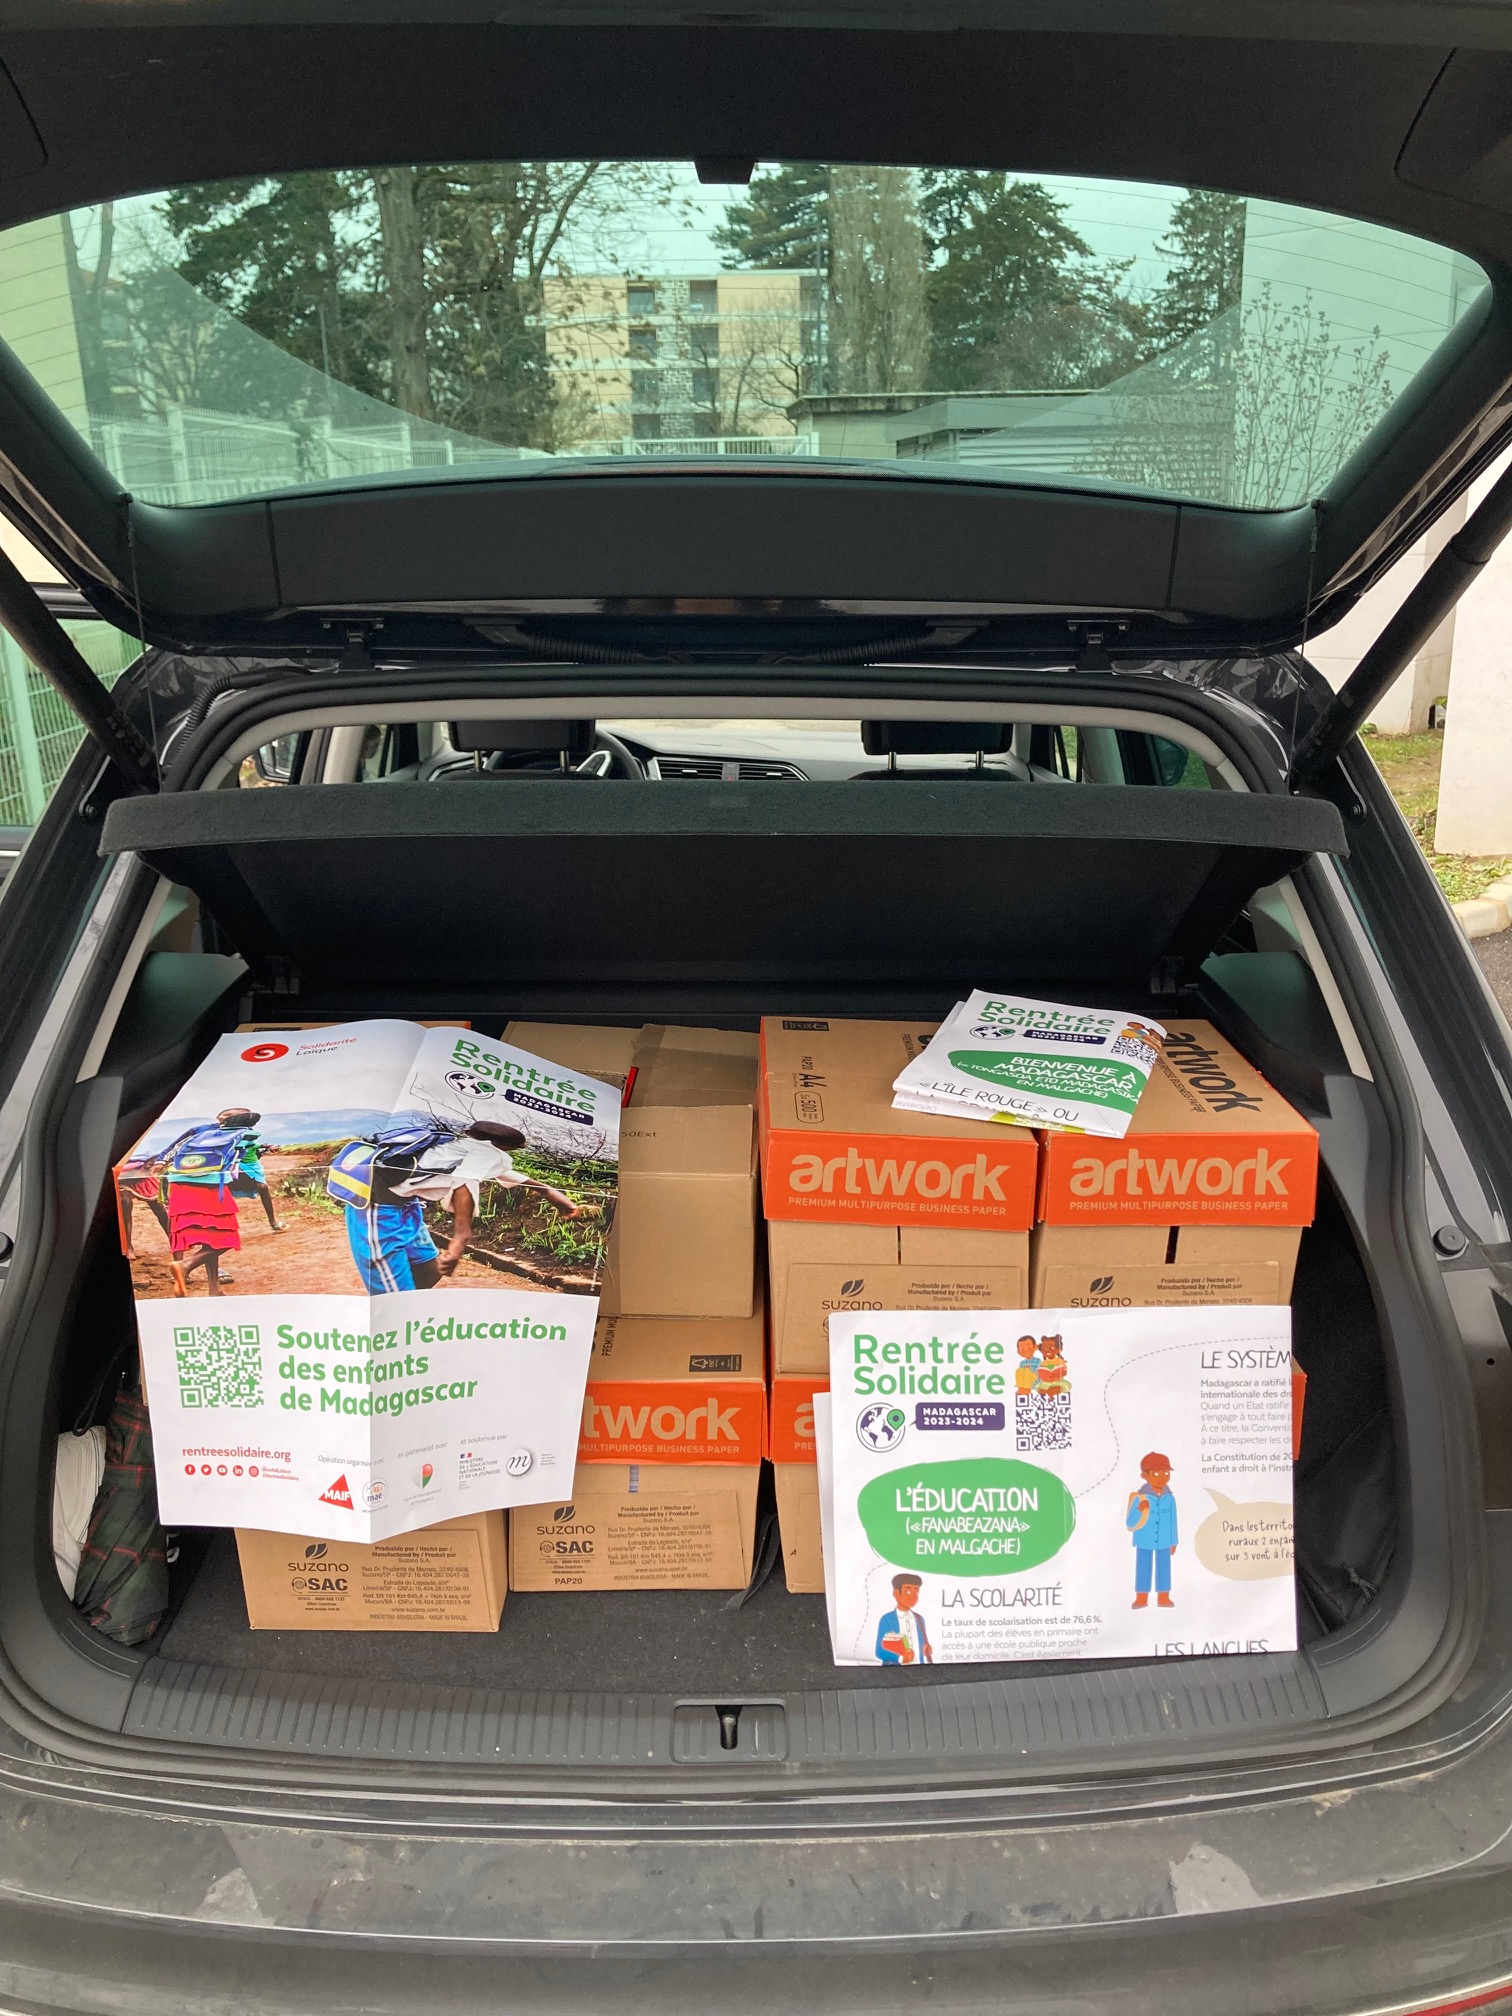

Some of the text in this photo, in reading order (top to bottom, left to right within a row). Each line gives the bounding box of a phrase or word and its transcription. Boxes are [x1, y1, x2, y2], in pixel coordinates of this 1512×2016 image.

[984, 1001, 1115, 1026] Rentrée
[978, 1012, 1112, 1034] Solidaire
[1032, 1031, 1098, 1041] MADAGASCAR
[299, 1037, 357, 1050] Solidarité
[802, 1056, 813, 1070] PAP20
[455, 1039, 597, 1101] Rentrée
[970, 1064, 1059, 1084] TONGASOA ETO
[994, 1062, 1133, 1091] MADAGASCAR
[1011, 1057, 1136, 1084] BIENVENUE À
[1162, 1032, 1263, 1112] artwork
[450, 1052, 595, 1112] Solidaire
[799, 1073, 827, 1087] A4
[513, 1092, 585, 1119] MADAGASCAR
[801, 1100, 817, 1112] 500
[1053, 1108, 1079, 1121] OU
[789, 1147, 1010, 1201] artwork
[1069, 1148, 1292, 1197] artwork
[788, 1197, 1006, 1216] PREMIUM MULTIPURPOSE BUSINESS PAPER
[1070, 1201, 1288, 1211] PREMIUM MULTIPURPOSE BUSINESS PAPER
[822, 1300, 883, 1311] suzano
[1071, 1297, 1132, 1307] suzano
[277, 1317, 567, 1353] Soutenez l'éducation
[854, 1332, 1004, 1364] Rentrée
[1201, 1351, 1222, 1369] LE
[279, 1354, 429, 1385] des enfants
[854, 1365, 1005, 1395] Solidaire
[1201, 1379, 1252, 1389] Madagascar
[280, 1378, 478, 1417] de Madagascar
[1263, 1390, 1278, 1398] des
[923, 1407, 997, 1416] MADAGASCAR
[1201, 1402, 1230, 1410] Quand
[1266, 1401, 1289, 1409] ratifie
[583, 1396, 741, 1441] twork
[923, 1417, 984, 1425] 2023-2024
[1201, 1412, 1285, 1423] s'engage à tout faire
[1201, 1424, 1208, 1432] À
[1221, 1425, 1239, 1433] titre,
[468, 1435, 496, 1444] soutenue
[1228, 1436, 1268, 1445] respecter
[182, 1447, 291, 1463] rentreesolidaire.org
[405, 1445, 434, 1458] partenariat
[435, 1442, 448, 1451] avec
[656, 1444, 705, 1454] BUSINESS
[707, 1446, 739, 1454] PAPER
[318, 1455, 384, 1468] Opération organisée avec
[1201, 1454, 1212, 1462] La
[479, 1470, 500, 1478] JEUNESSE
[1201, 1465, 1229, 1473] enfant
[1239, 1464, 1259, 1472] droit
[1261, 1464, 1267, 1472] à
[325, 1489, 350, 1502] MAIF
[367, 1493, 383, 1502] mae
[896, 1482, 1038, 1513] L'ÉDUCATION
[536, 1524, 596, 1535] suzano
[906, 1516, 1030, 1535] («FANABEAZANA»
[1222, 1520, 1244, 1532] Dans
[1247, 1521, 1258, 1531] les
[555, 1541, 594, 1554] SAC
[916, 1538, 1020, 1555] EN MALGACHE)
[1229, 1538, 1258, 1546] ruraux
[1262, 1537, 1266, 1545] 2
[1243, 1552, 1248, 1560] 3
[1251, 1548, 1271, 1560] vont
[1274, 1548, 1278, 1558] à
[288, 1562, 349, 1572] suzano
[308, 1578, 348, 1591] SAC
[942, 1582, 1062, 1608] LA SCOLARITÉ
[942, 1618, 953, 1626] Le
[975, 1617, 986, 1626] de
[988, 1617, 1043, 1626] scolarisation
[1059, 1615, 1071, 1624] de
[942, 1630, 952, 1639] La
[954, 1630, 986, 1639] plupart
[988, 1629, 1003, 1637] des
[1005, 1627, 1032, 1637] élèves
[1047, 1628, 1082, 1637] primaire
[942, 1639, 1087, 1650] accès à une école publique proche
[941, 1652, 953, 1661] de
[955, 1652, 971, 1660] leur
[1037, 1649, 1082, 1658] également
